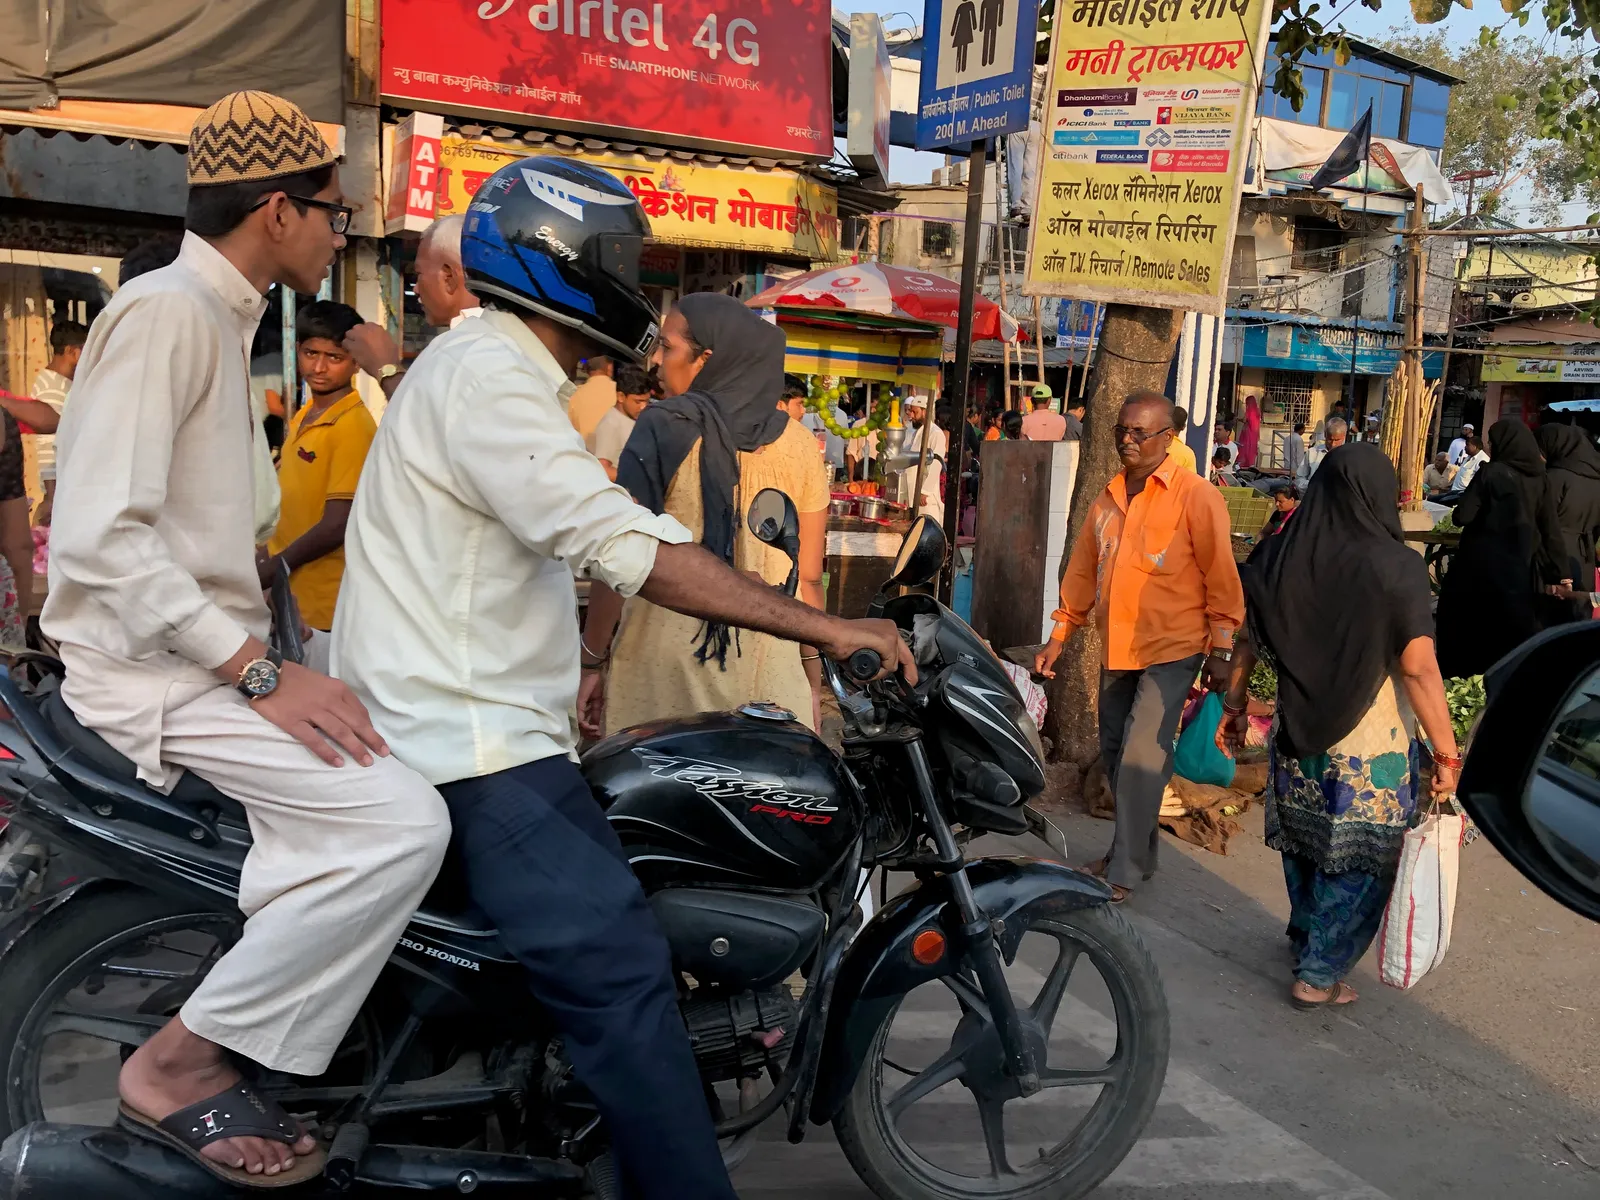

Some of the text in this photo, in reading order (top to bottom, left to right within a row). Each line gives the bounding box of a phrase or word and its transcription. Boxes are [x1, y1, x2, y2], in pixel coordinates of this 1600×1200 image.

[692, 13, 760, 67] 4G
[581, 52, 761, 92] THE SMARTPHONE NETWORK
[1065, 39, 1126, 76] मनी
[413, 70, 439, 85] बाबा
[515, 83, 556, 102] मोबाईल
[560, 90, 582, 105] शॉप
[974, 89, 1000, 109] Public
[1003, 83, 1026, 102] Toilet
[935, 111, 1008, 140] 200 M. Ahead
[1053, 151, 1089, 160] citibank
[409, 141, 436, 211] ATM
[1052, 181, 1082, 201] कलर
[1083, 177, 1119, 201] Xerox
[1183, 179, 1223, 204] Xerox
[534, 225, 579, 262] Energy
[1046, 210, 1083, 237] ऑल
[1087, 210, 1151, 243] मोबाईल
[1042, 249, 1066, 273] ऑल
[1133, 256, 1175, 281] Remote
[1177, 258, 1211, 283] Sales
[750, 804, 832, 825] PRO
[397, 937, 480, 972] RO HONDA
